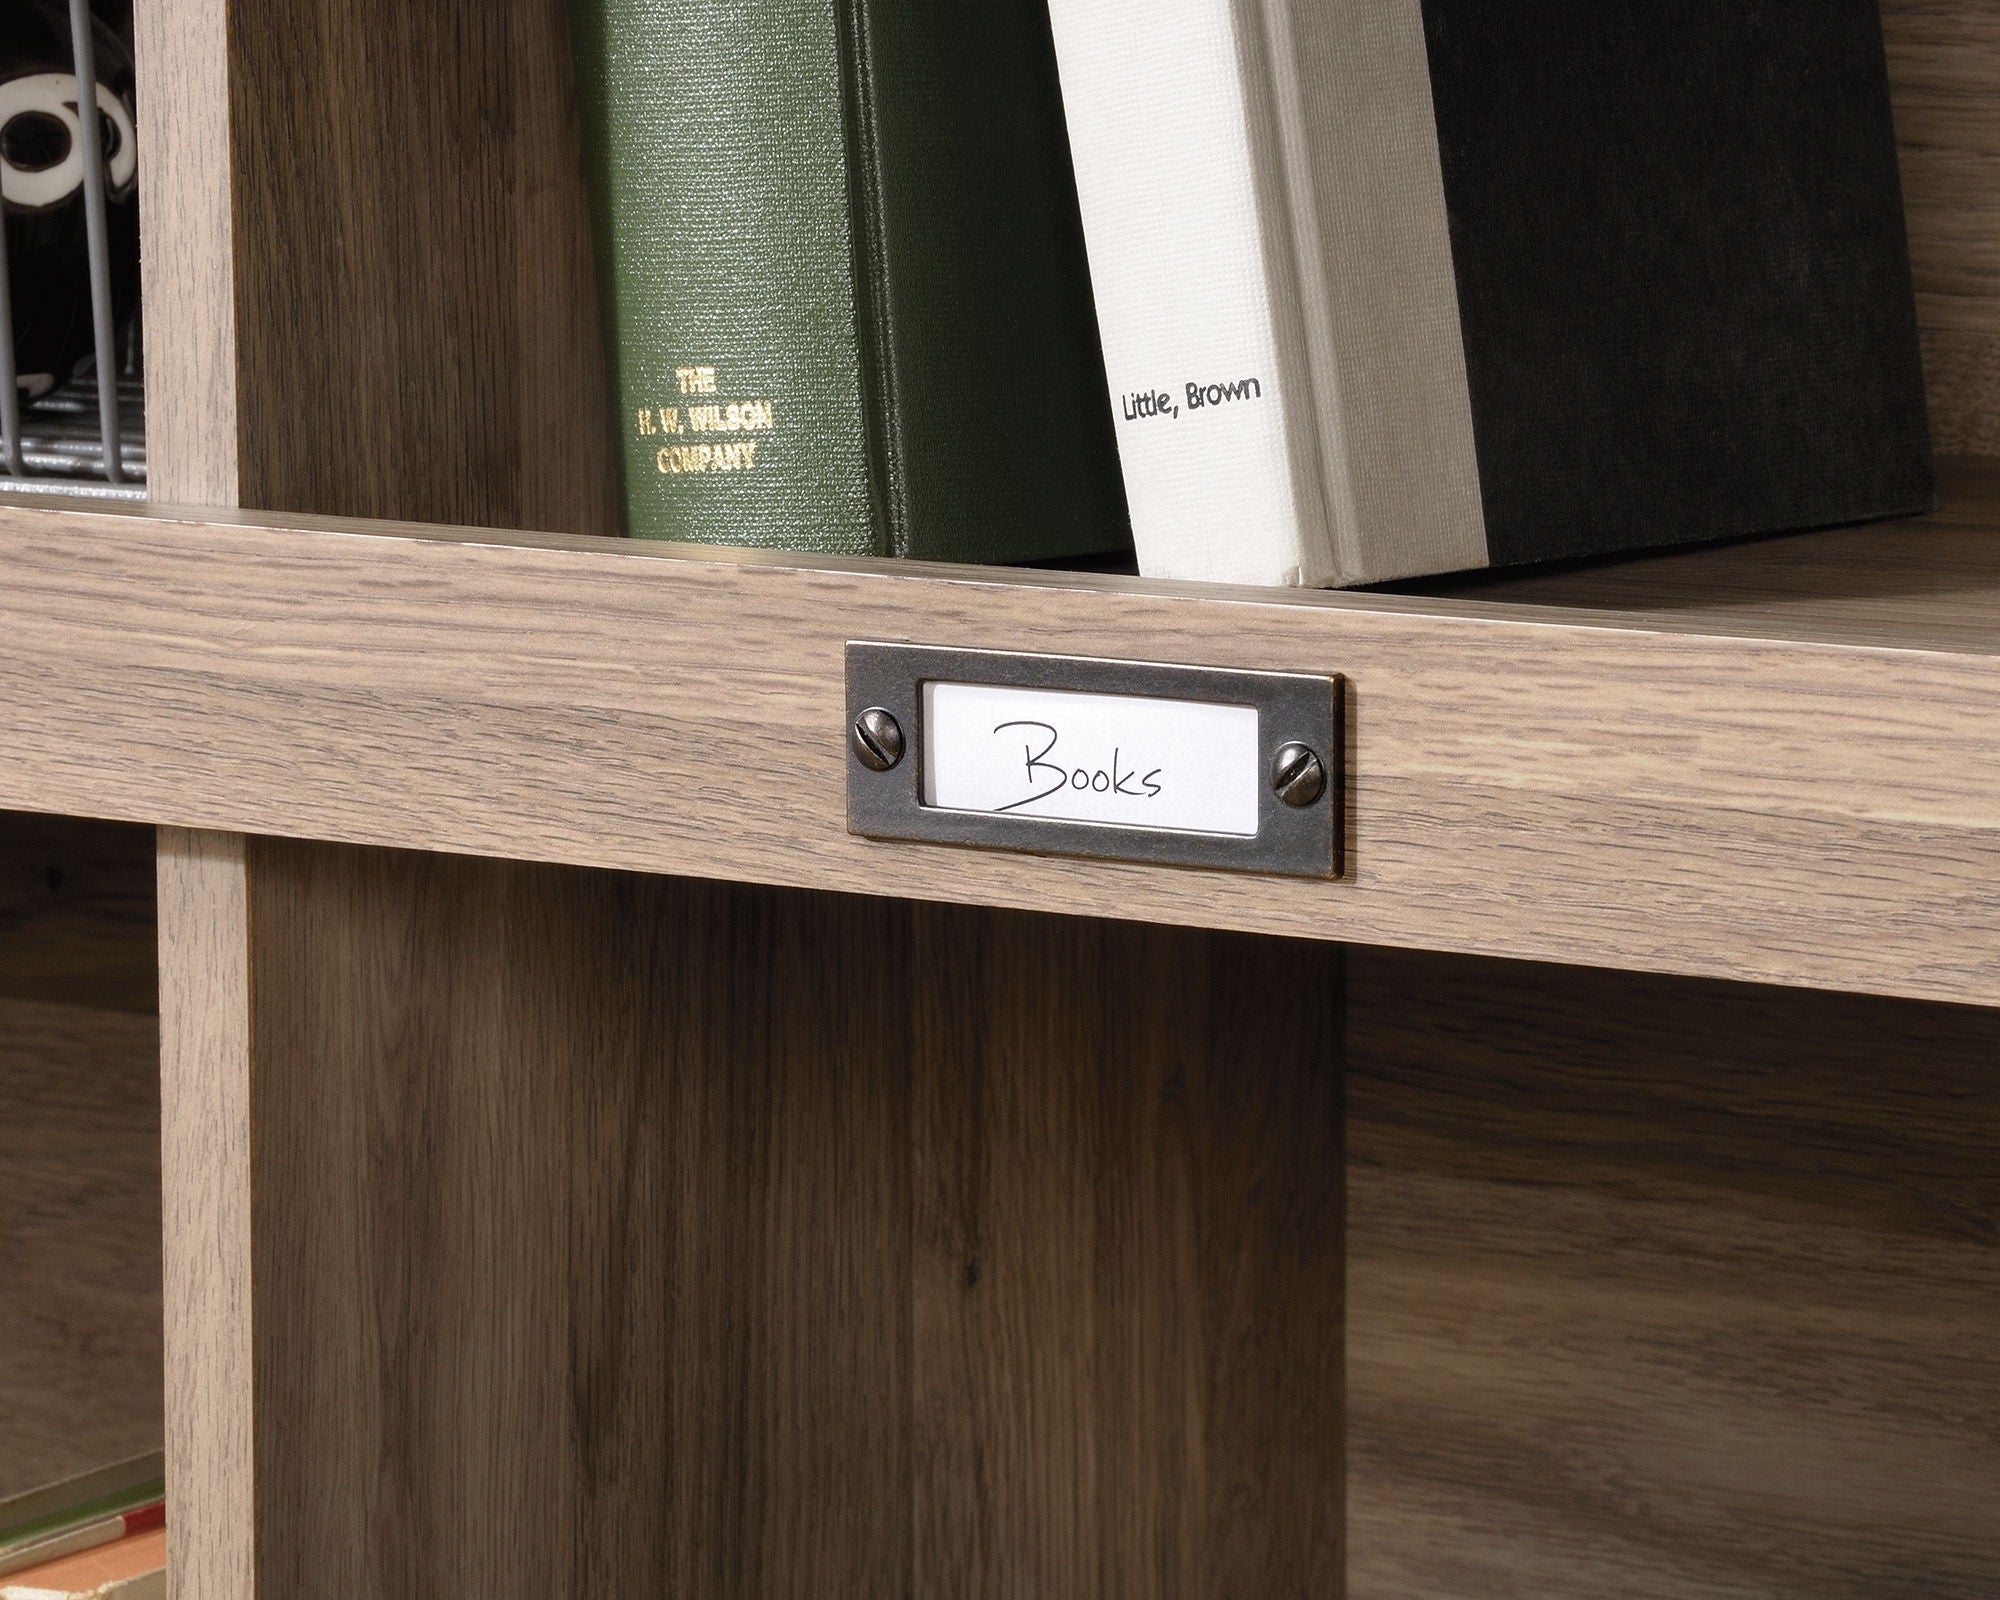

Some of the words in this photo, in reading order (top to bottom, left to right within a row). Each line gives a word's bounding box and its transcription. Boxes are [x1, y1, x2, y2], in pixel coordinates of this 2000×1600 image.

[675, 365, 717, 394] THE
[1122, 389, 1179, 421] Little,
[1185, 377, 1261, 410] Brown
[638, 406, 656, 435] H.
[659, 406, 684, 434] W.
[688, 400, 773, 432] WILSON
[656, 441, 757, 474] COMPANY
[993, 721, 1162, 812] Books
